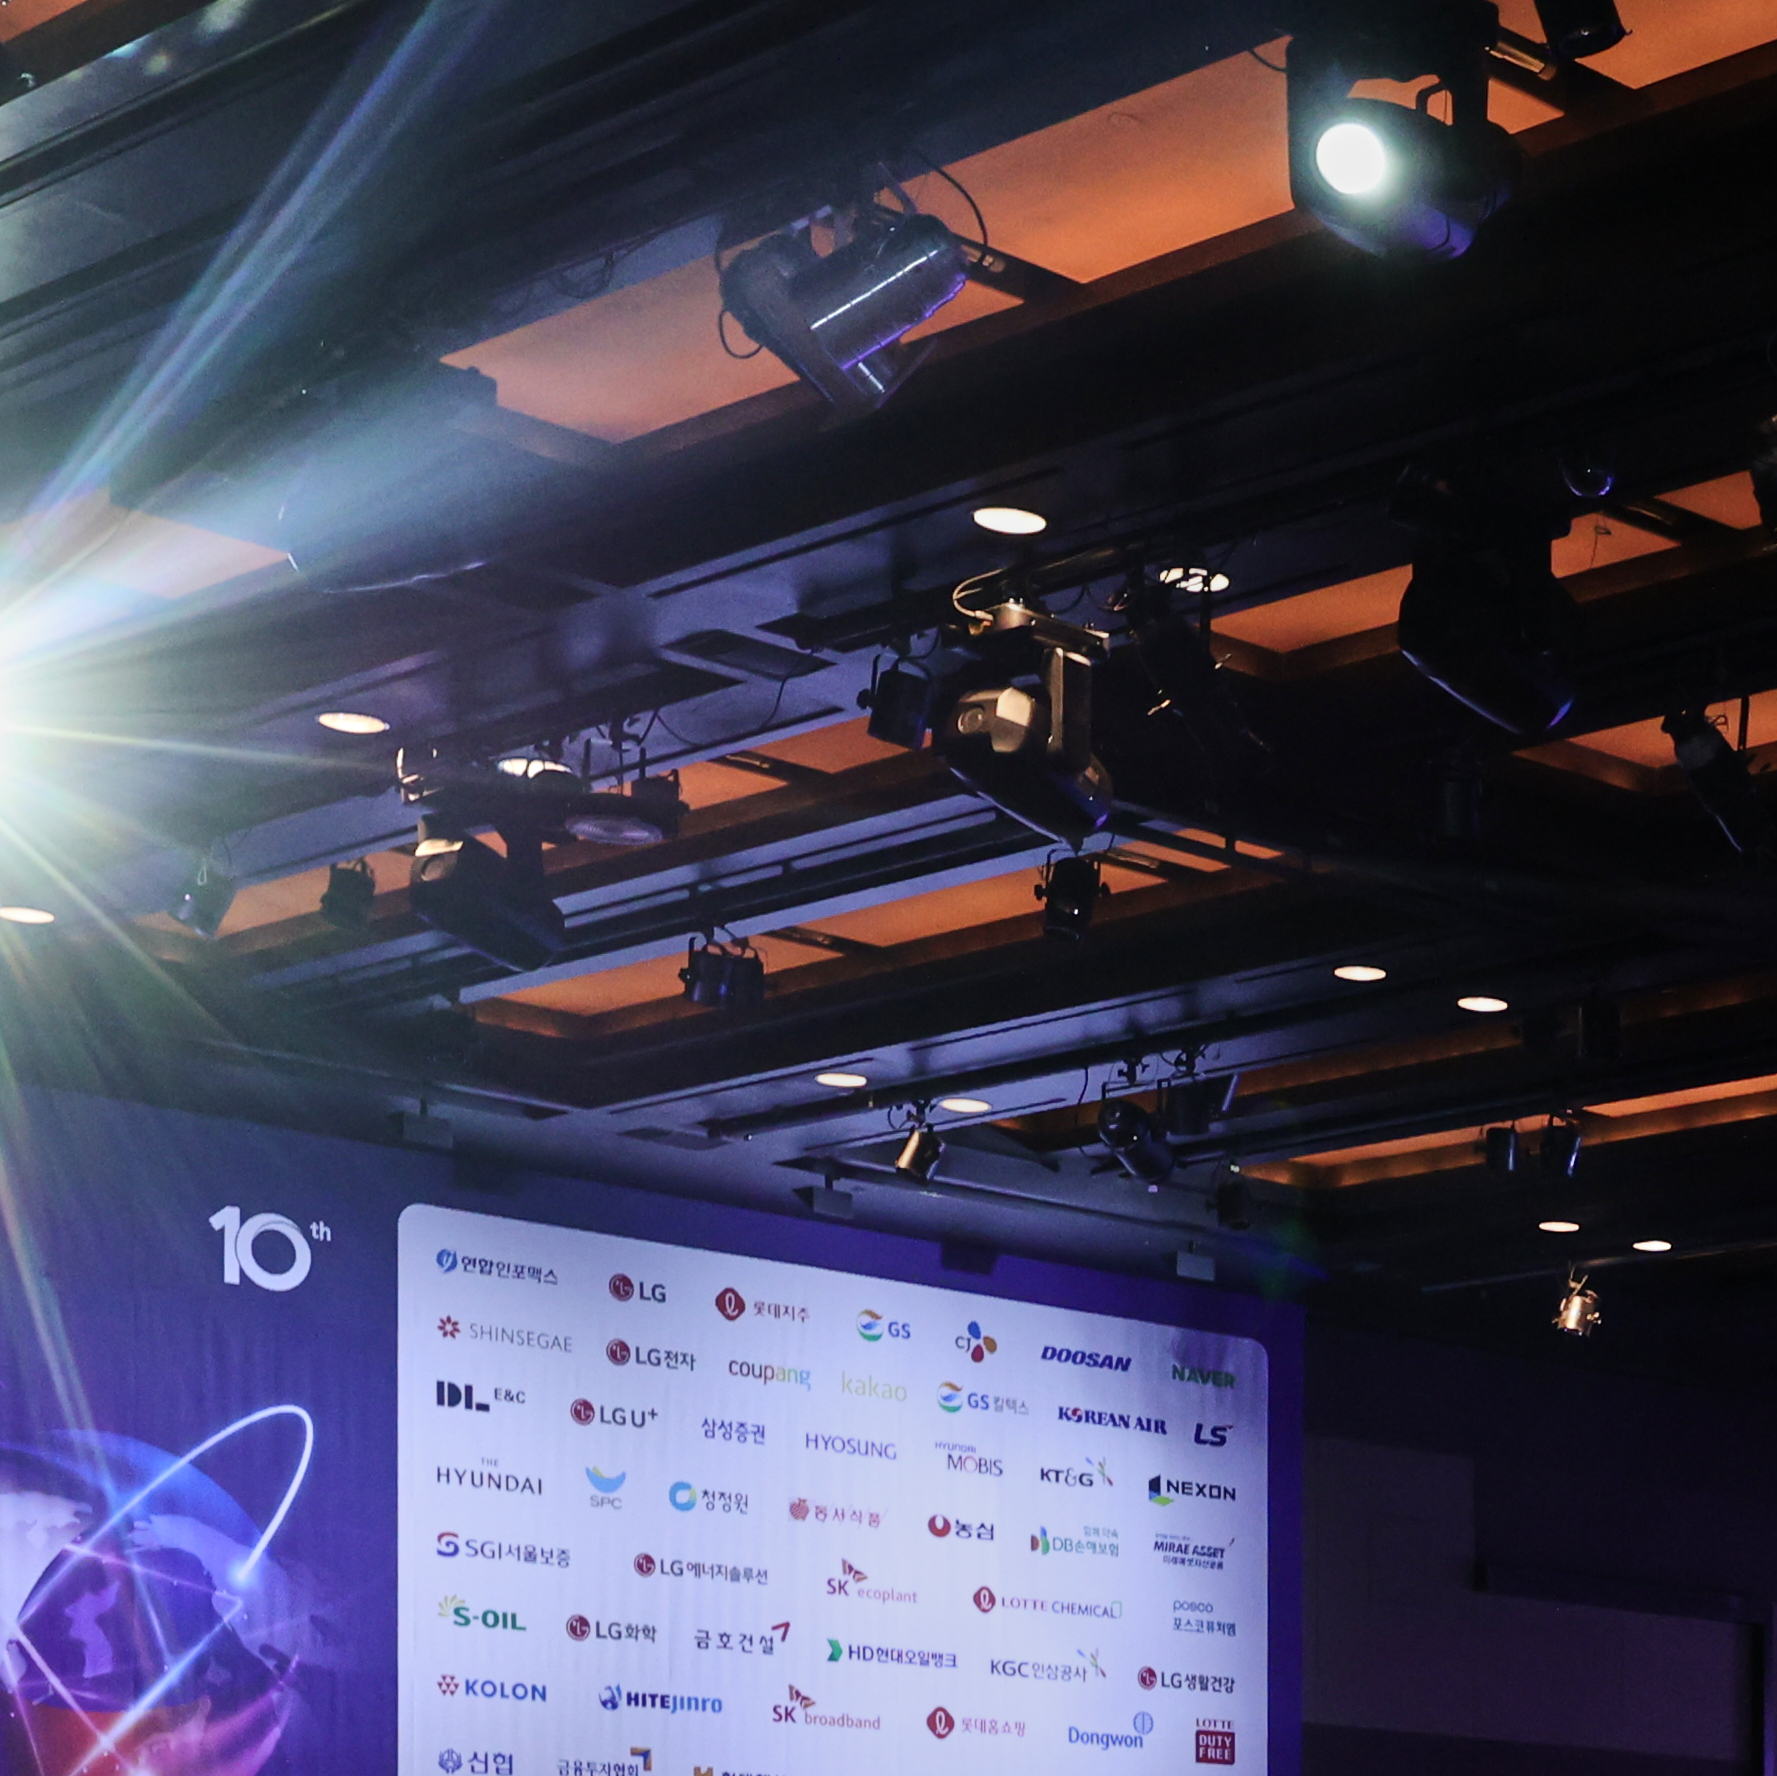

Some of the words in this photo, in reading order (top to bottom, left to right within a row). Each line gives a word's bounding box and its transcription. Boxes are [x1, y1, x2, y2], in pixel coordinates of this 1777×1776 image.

[209, 1204, 331, 1292] 10th
[461, 1256, 558, 1286] 연합인포맥스
[639, 1281, 666, 1303] LG
[753, 1301, 810, 1323] 롯데지주
[469, 1322, 573, 1353] SHINSEGAE
[888, 1321, 911, 1340] GS
[955, 1335, 972, 1353] CJ
[1041, 1345, 1132, 1373] DOOSAN
[729, 1359, 812, 1392] coupang
[841, 1371, 908, 1402] kakao
[1172, 1364, 1236, 1388] NAVER
[494, 1387, 526, 1405] E&C
[967, 1393, 990, 1411] GS
[702, 1416, 766, 1446] 삼성증권
[1058, 1405, 1131, 1431] KOREAN
[1134, 1416, 1168, 1435] AIR
[806, 1433, 897, 1461] HYOSUNG
[1194, 1423, 1228, 1447] LS
[947, 1453, 1004, 1476] MOBIS
[437, 1467, 543, 1495] HYUNDAI
[1040, 1467, 1095, 1488] KT&G
[701, 1489, 749, 1515] 청정원
[1166, 1478, 1237, 1502] NEXON
[589, 1494, 623, 1511] SPC
[955, 1518, 995, 1542] 농심
[1153, 1539, 1191, 1556] MIRAE
[827, 1578, 849, 1597] SK
[857, 1586, 918, 1605] ecoplant
[452, 1606, 527, 1632] S-OIL
[1002, 1596, 1048, 1612] LOTTE
[1051, 1600, 1118, 1619] CHEMICAL
[1173, 1599, 1214, 1616] posco
[465, 1678, 548, 1703] KOLON
[772, 1704, 797, 1724] SK
[804, 1711, 881, 1731] broadband
[961, 1717, 1026, 1738] 롯데홈쇼핑
[1068, 1726, 1144, 1750] Dongwon
[1198, 1733, 1233, 1749] DUTY
[468, 1751, 514, 1776] 신협
[1198, 1746, 1233, 1761] FREE
